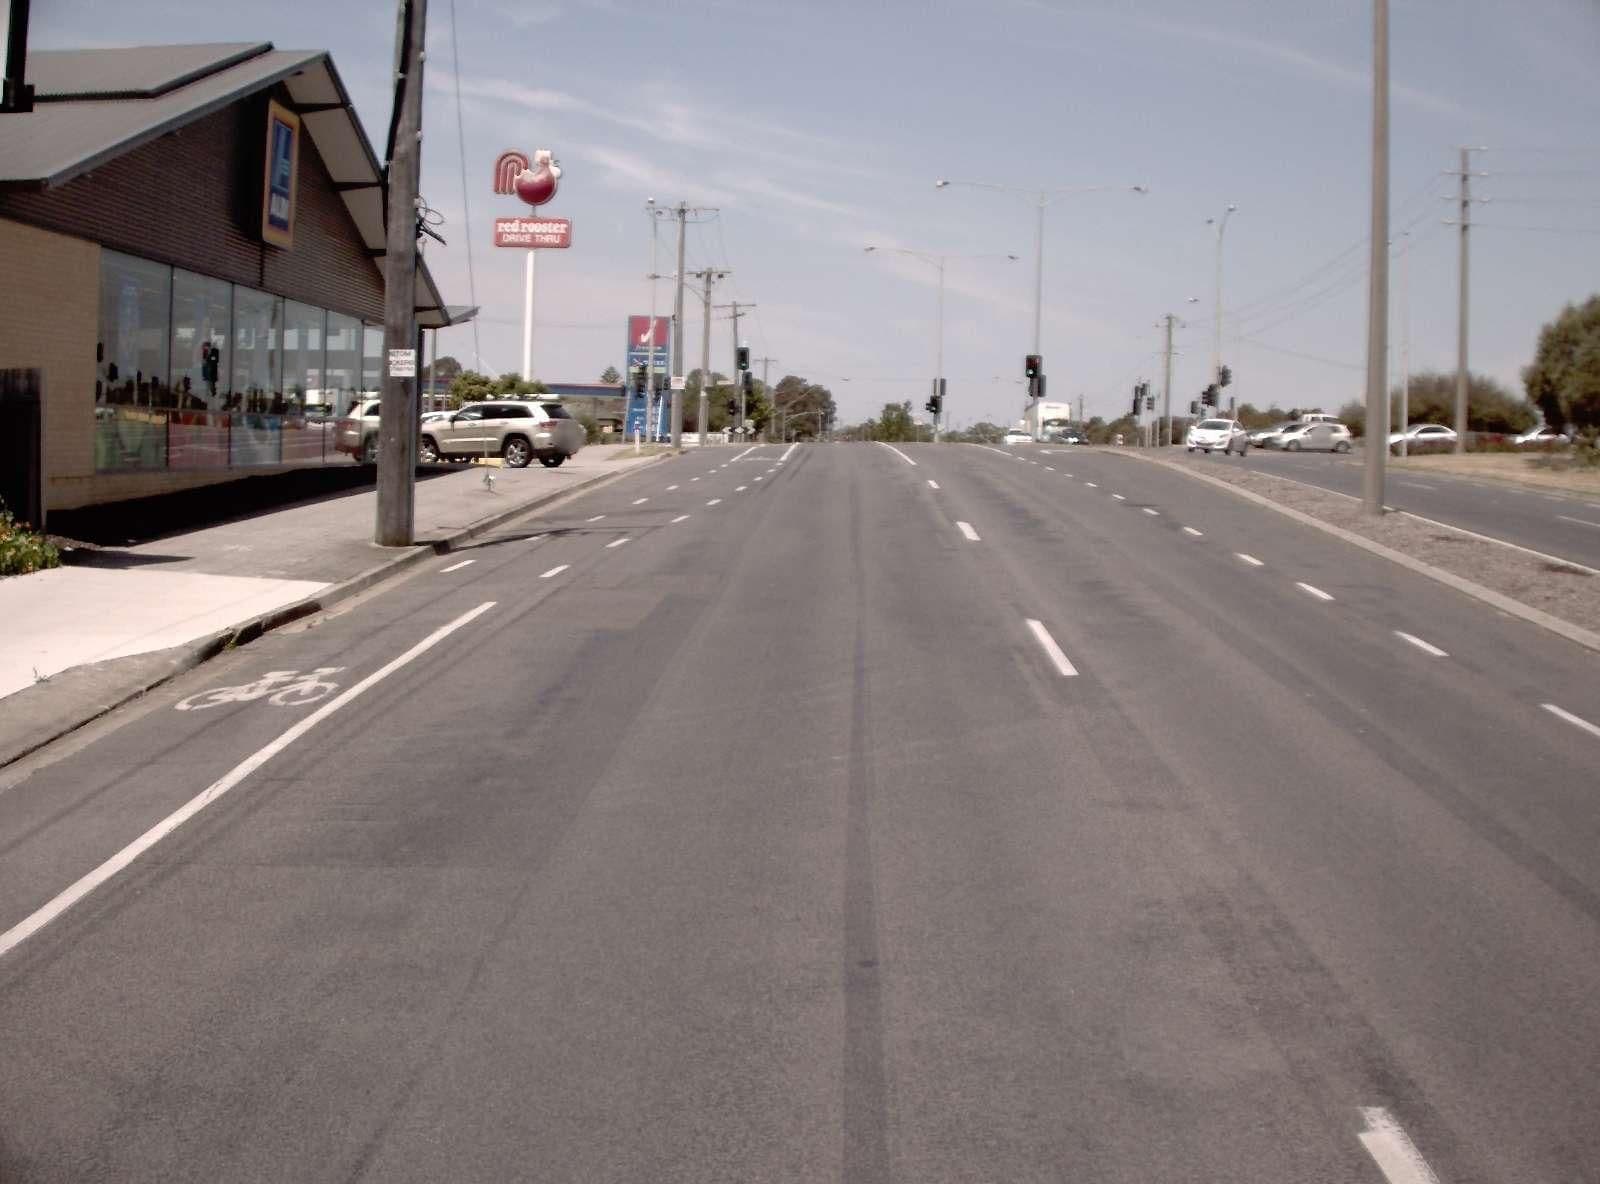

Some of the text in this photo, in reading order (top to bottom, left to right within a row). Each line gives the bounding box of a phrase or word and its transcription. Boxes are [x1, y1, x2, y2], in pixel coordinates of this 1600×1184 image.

[497, 220, 568, 234] red rooster
[502, 234, 560, 243] DRIVE THRU
